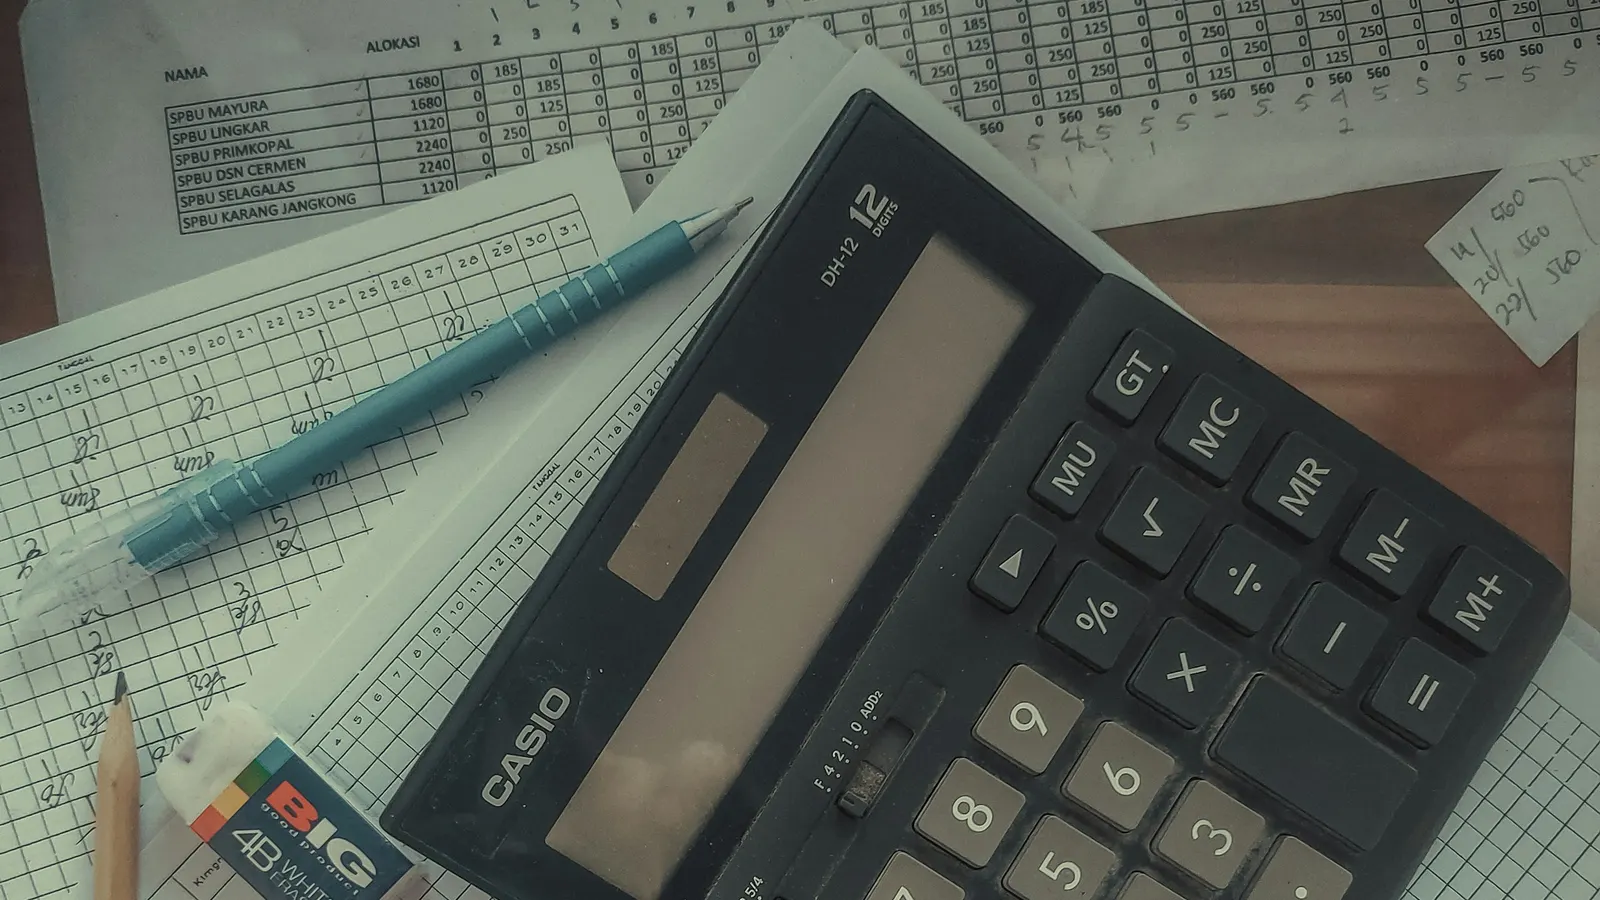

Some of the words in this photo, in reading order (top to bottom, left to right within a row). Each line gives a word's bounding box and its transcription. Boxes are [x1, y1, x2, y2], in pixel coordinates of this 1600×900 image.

[164, 65, 208, 82] NAMA
[366, 36, 420, 54] ALOKASI
[453, 41, 462, 51] 1
[493, 35, 501, 46] 2
[532, 29, 541, 39] 3
[572, 23, 580, 34] 4
[611, 19, 619, 30] 5
[649, 13, 657, 24] 6
[686, 7, 695, 18] 7
[727, 2, 735, 12] 8
[169, 108, 205, 125] SPBU
[208, 100, 269, 121] MAYURA
[407, 75, 440, 91] 1680
[494, 65, 518, 78] 185
[652, 42, 674, 56] 185
[922, 4, 944, 17] 185
[172, 129, 207, 146] SPBU
[211, 119, 270, 141] LINGKAR
[410, 95, 443, 111] 1680
[537, 79, 560, 92] 185
[693, 57, 716, 71] 185
[964, 18, 987, 32] 185
[175, 149, 210, 166] SPBU
[213, 138, 294, 162] PRIMKOPAL
[413, 117, 445, 133] 1120
[540, 100, 564, 114] 125
[696, 78, 719, 92] 125
[967, 38, 990, 52] 125
[1085, 21, 1108, 35] 125
[178, 170, 212, 187] SPBU
[216, 166, 244, 183] DSN
[248, 157, 306, 177] CERMEN
[416, 137, 448, 153] 2240
[504, 127, 527, 140] 250
[660, 105, 683, 119] 250
[931, 65, 954, 79] 250
[1048, 48, 1072, 62] 250
[1202, 25, 1225, 39] 250
[1318, 9, 1342, 23] 250
[180, 191, 215, 208] SPBU
[218, 180, 296, 204] SELAGALAS
[419, 157, 451, 174] 2240
[974, 80, 997, 93] 250
[1091, 63, 1115, 76] 250
[1244, 40, 1268, 54] 250
[1360, 24, 1384, 38] 250
[1512, 1, 1536, 14] 250
[980, 121, 1004, 136] 560
[1058, 110, 1082, 124] 560
[1098, 104, 1122, 119] 560
[1212, 88, 1236, 102] 560
[1250, 82, 1274, 96] 560
[1328, 72, 1352, 85] 560
[1367, 66, 1390, 80] 560
[1480, 49, 1504, 63] 560
[1520, 42, 1544, 57] 560
[183, 212, 218, 229] SPBU
[221, 204, 279, 225] KARANG
[281, 192, 357, 218] JANGKONG
[422, 179, 454, 195] 1120
[1056, 89, 1080, 103] 125
[1208, 67, 1232, 81] 125
[1326, 51, 1349, 64] 125
[1478, 28, 1501, 42] 125
[850, 183, 890, 230] 12
[872, 201, 899, 238] DIGITS
[1490, 189, 1525, 222] 560
[820, 236, 860, 288] DH-12
[8, 403, 26, 414] 13
[65, 384, 82, 395] 15
[93, 374, 111, 385] 16
[121, 364, 138, 376] 17
[151, 354, 168, 365] 18
[179, 345, 197, 356] 19
[208, 336, 226, 348] 20
[236, 327, 254, 339] 21
[266, 316, 286, 328] 22
[296, 306, 316, 320] 23
[358, 286, 378, 300] 25
[390, 276, 412, 290] 26
[424, 264, 444, 279] 27
[492, 244, 513, 258] 29
[525, 232, 548, 248] 30
[560, 222, 580, 237] 31
[1114, 348, 1154, 397] GT
[1188, 396, 1241, 460] MC
[1050, 440, 1098, 497] MU
[1277, 456, 1331, 518] MR
[335, 738, 342, 746] 4
[353, 715, 362, 725] 5
[374, 693, 382, 702] 6
[392, 670, 402, 680] 7
[413, 649, 422, 659] 8
[450, 601, 464, 616] 10
[470, 580, 484, 595] 11
[489, 557, 504, 573] 12
[508, 535, 524, 552] 13
[528, 514, 543, 529] 14
[548, 491, 563, 506] 15
[568, 470, 583, 485] 16
[588, 446, 602, 463] 17
[608, 426, 622, 440] 18
[627, 402, 642, 418] 19
[646, 380, 661, 398] 20
[1454, 574, 1504, 633] M+
[482, 687, 570, 807] CASIO
[1010, 701, 1049, 737] 9
[824, 764, 836, 777] 4
[832, 749, 845, 762] 2
[1103, 760, 1140, 796] 6
[266, 780, 377, 888] BIG
[952, 796, 993, 833] 8
[1191, 818, 1233, 858] 3
[232, 829, 283, 872] 4B
[260, 802, 299, 838] good
[299, 840, 359, 896] product
[1038, 850, 1082, 892] 5
[281, 859, 333, 900] WHIT
[744, 875, 764, 899] 5/4
